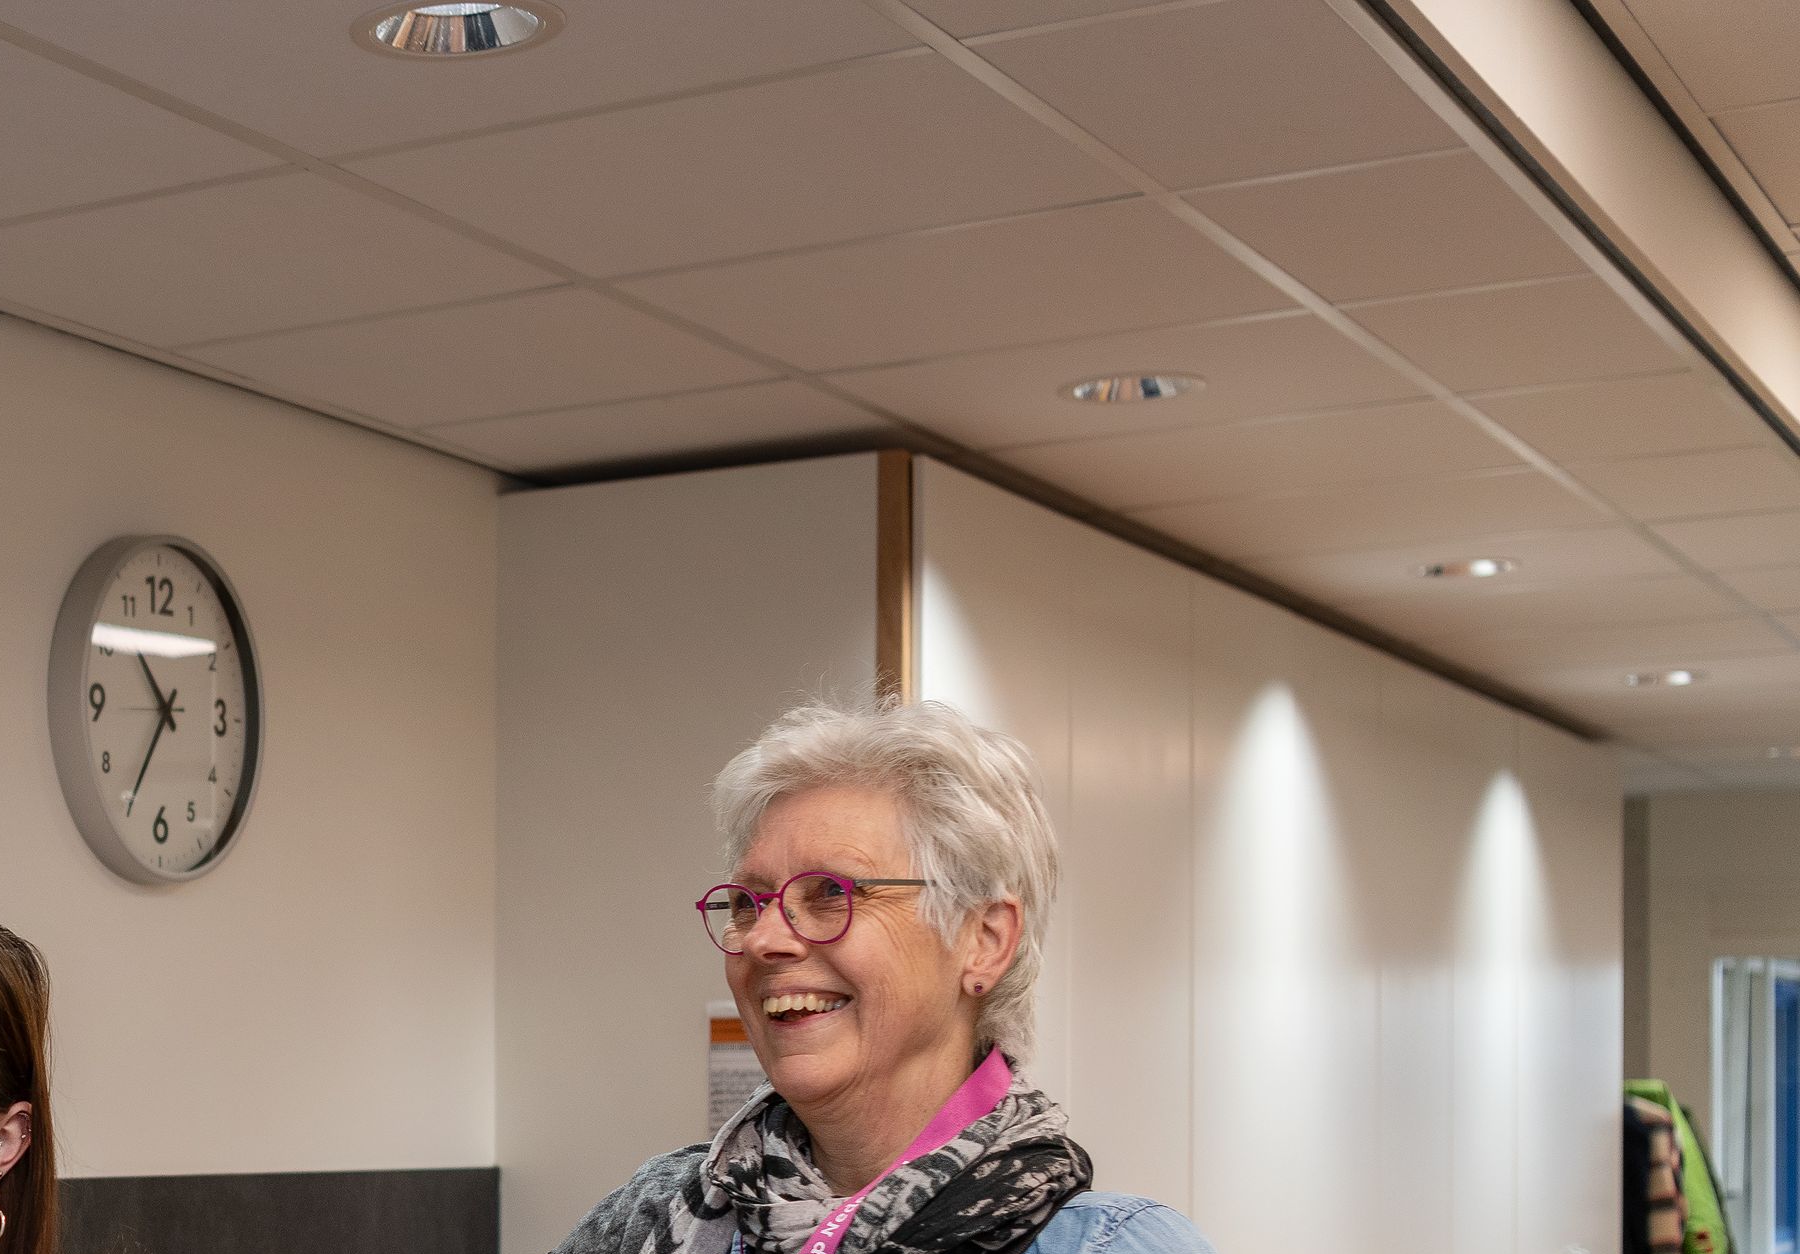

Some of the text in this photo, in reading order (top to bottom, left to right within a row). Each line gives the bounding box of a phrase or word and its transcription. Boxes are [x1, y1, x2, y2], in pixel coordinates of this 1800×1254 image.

[122, 594, 136, 618] 11
[145, 576, 174, 617] 12
[187, 605, 194, 627] 1
[89, 682, 106, 722] 9
[213, 699, 227, 737] 3
[101, 751, 111, 774] 8
[207, 765, 217, 784] 4
[186, 801, 196, 823] 5
[152, 805, 169, 845] 6
